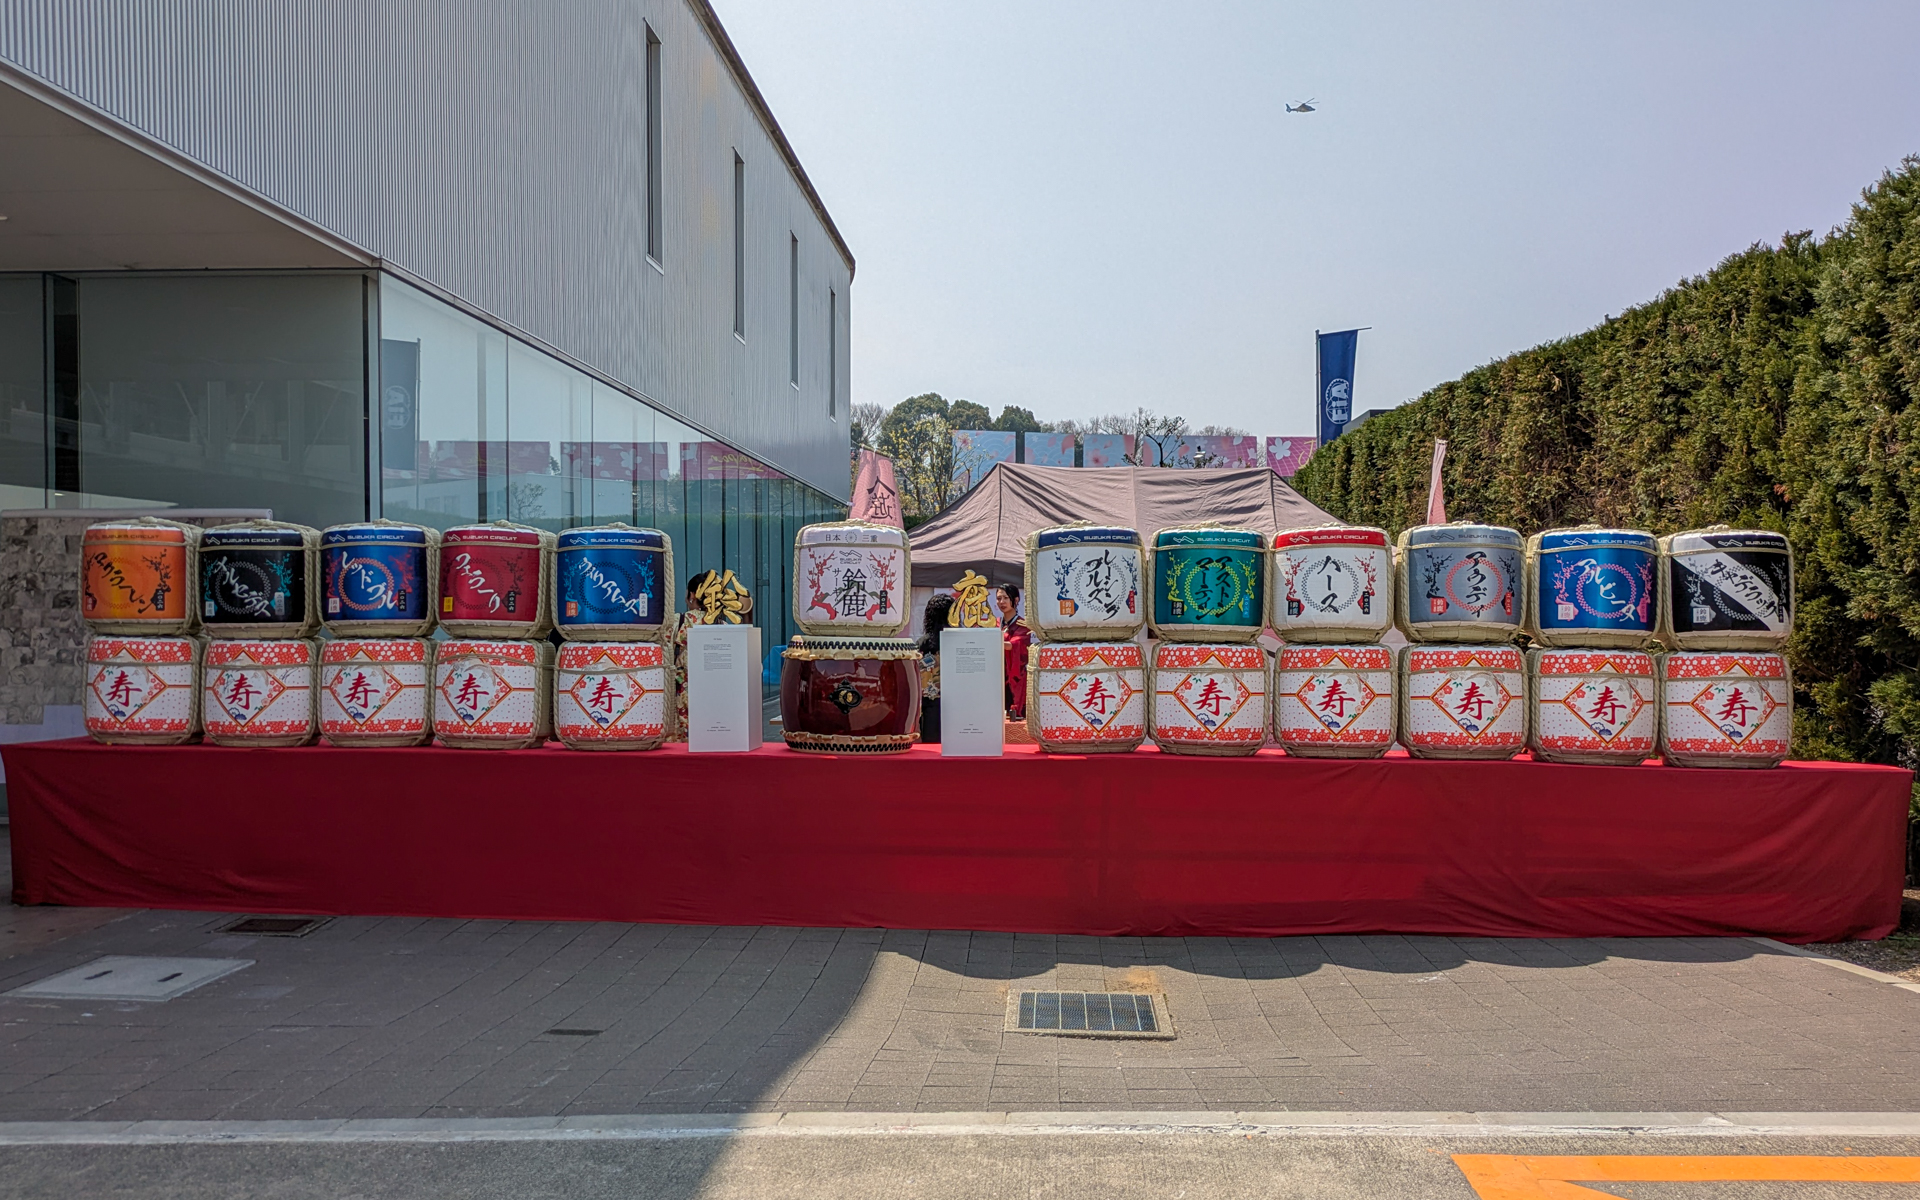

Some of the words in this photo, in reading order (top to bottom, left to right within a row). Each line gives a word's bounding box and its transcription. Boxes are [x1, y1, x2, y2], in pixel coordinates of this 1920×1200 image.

[862, 534, 878, 542] 三重
[94, 552, 151, 614] マクラーレン
[213, 556, 271, 617] メルセデス
[342, 551, 398, 610] レッドブル
[455, 553, 501, 614] フェラーリ
[695, 569, 750, 625] 鈴
[832, 567, 842, 617] サーキット
[842, 567, 867, 617] 鈴鹿
[947, 569, 997, 628] 鹿
[1085, 557, 1104, 604] ブルズ
[1103, 549, 1120, 621] レーシング
[1194, 557, 1214, 621] マーティン
[1215, 556, 1233, 618] アストン
[1317, 555, 1341, 614] ハース
[1465, 551, 1488, 618] アウディ
[1577, 558, 1636, 622] アルピーヌ
[1711, 559, 1778, 618] キャデラック
[106, 670, 142, 707] 寿
[225, 673, 262, 710] 寿
[343, 672, 380, 709] 寿
[456, 673, 490, 711] 寿
[585, 676, 624, 714] 寿
[1079, 677, 1116, 715] 寿
[1193, 678, 1231, 716] 寿
[1315, 679, 1356, 718] 寿
[1453, 682, 1493, 721] 寿
[1586, 686, 1627, 725] 寿
[1716, 688, 1758, 727] 寿
